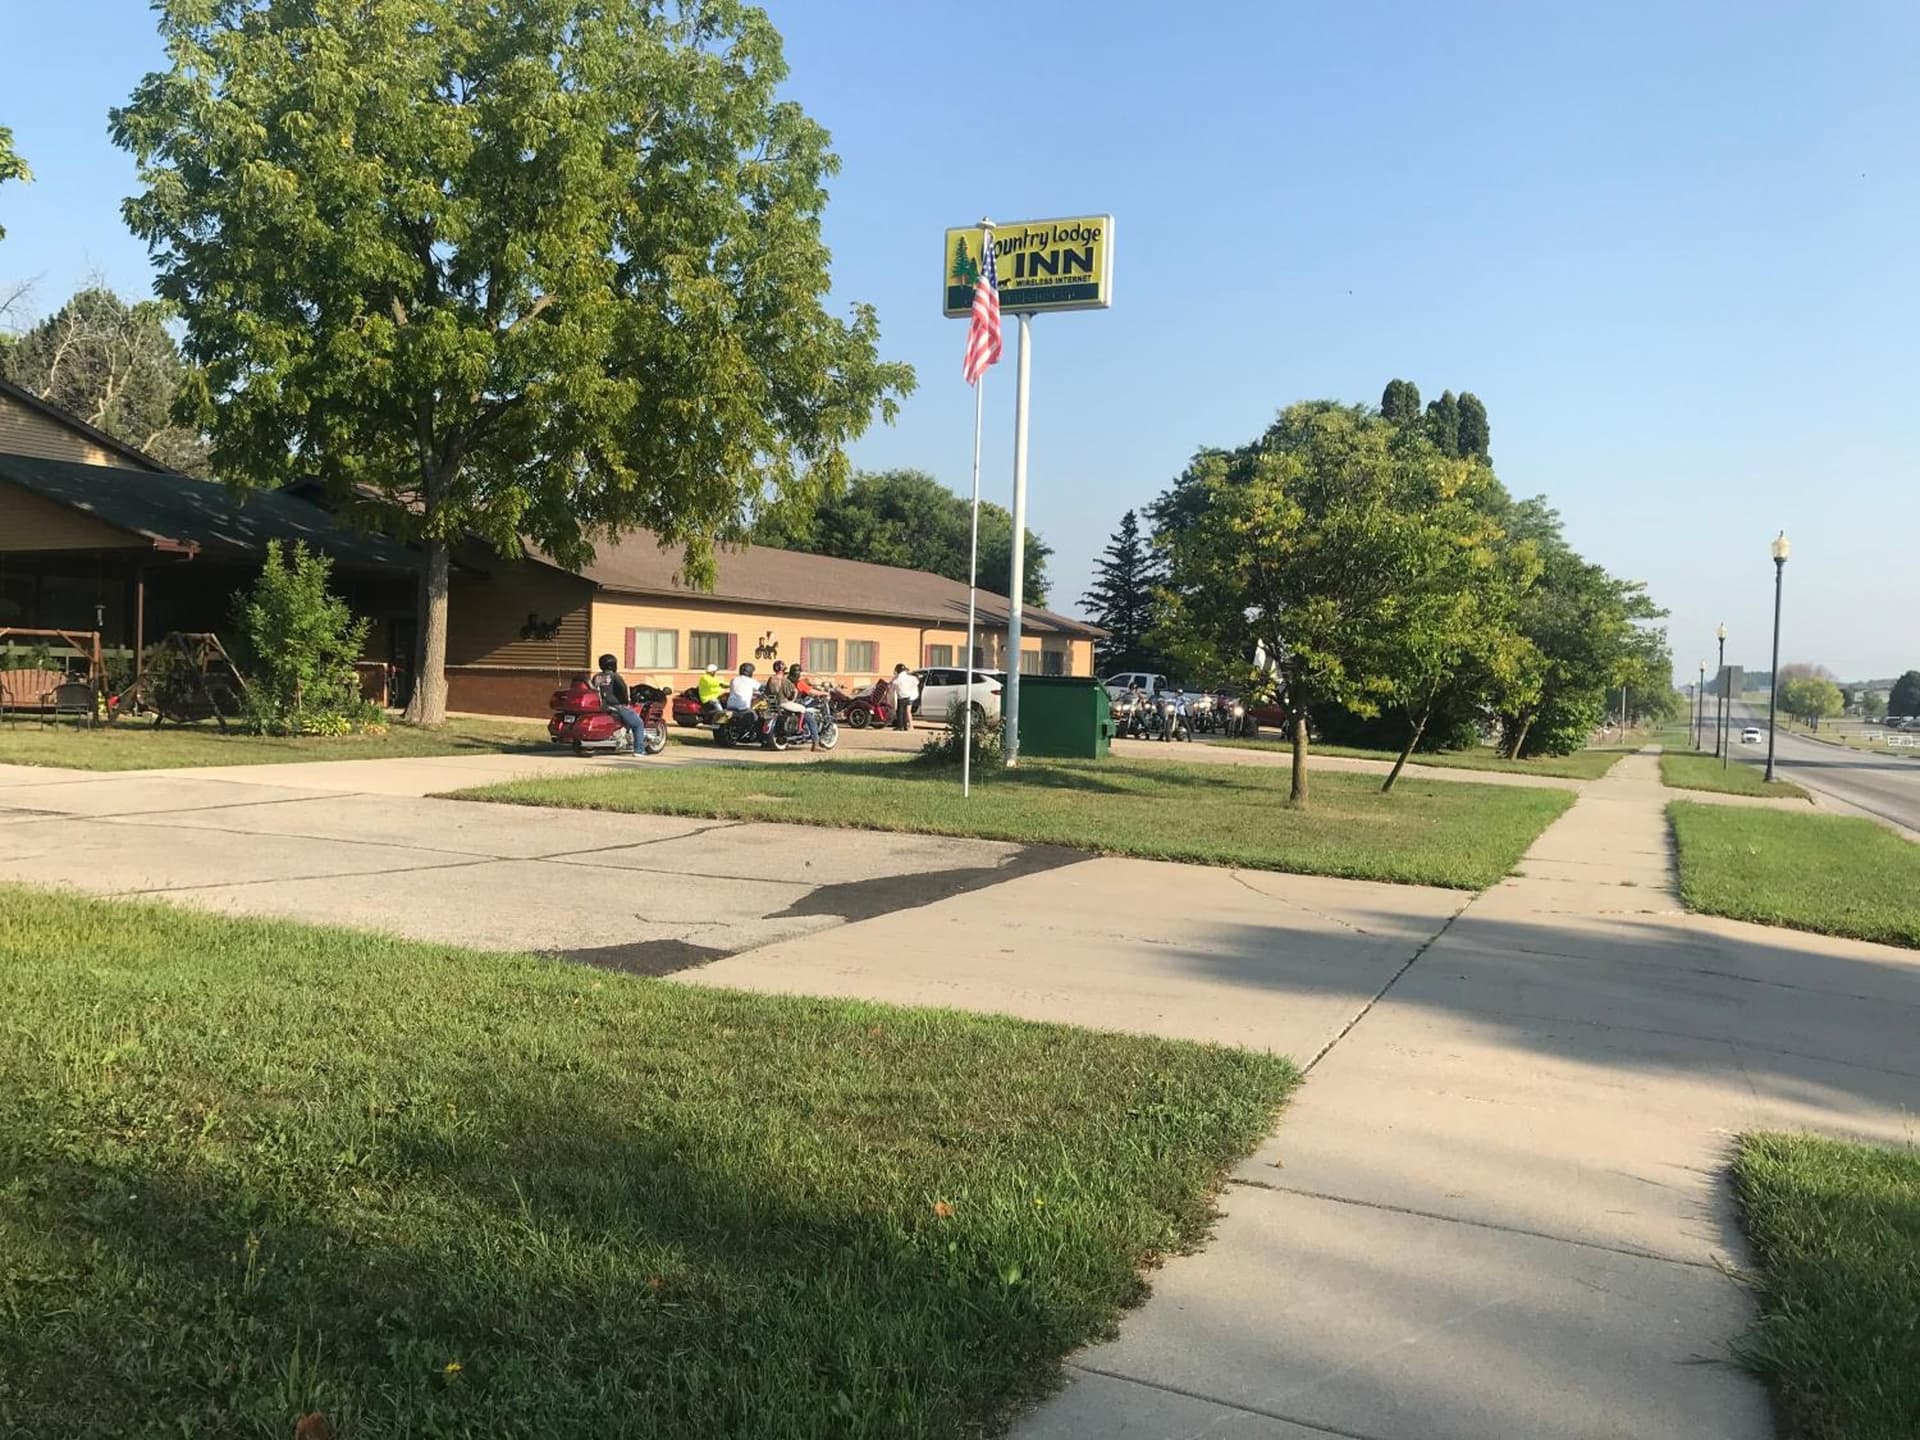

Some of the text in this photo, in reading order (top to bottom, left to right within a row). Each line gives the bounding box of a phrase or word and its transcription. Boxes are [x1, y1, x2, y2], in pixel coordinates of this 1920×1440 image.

[981, 228, 1048, 260] ountry
[1014, 247, 1093, 278] INN
[1016, 274, 1092, 286] WIRELESS INTERNET
